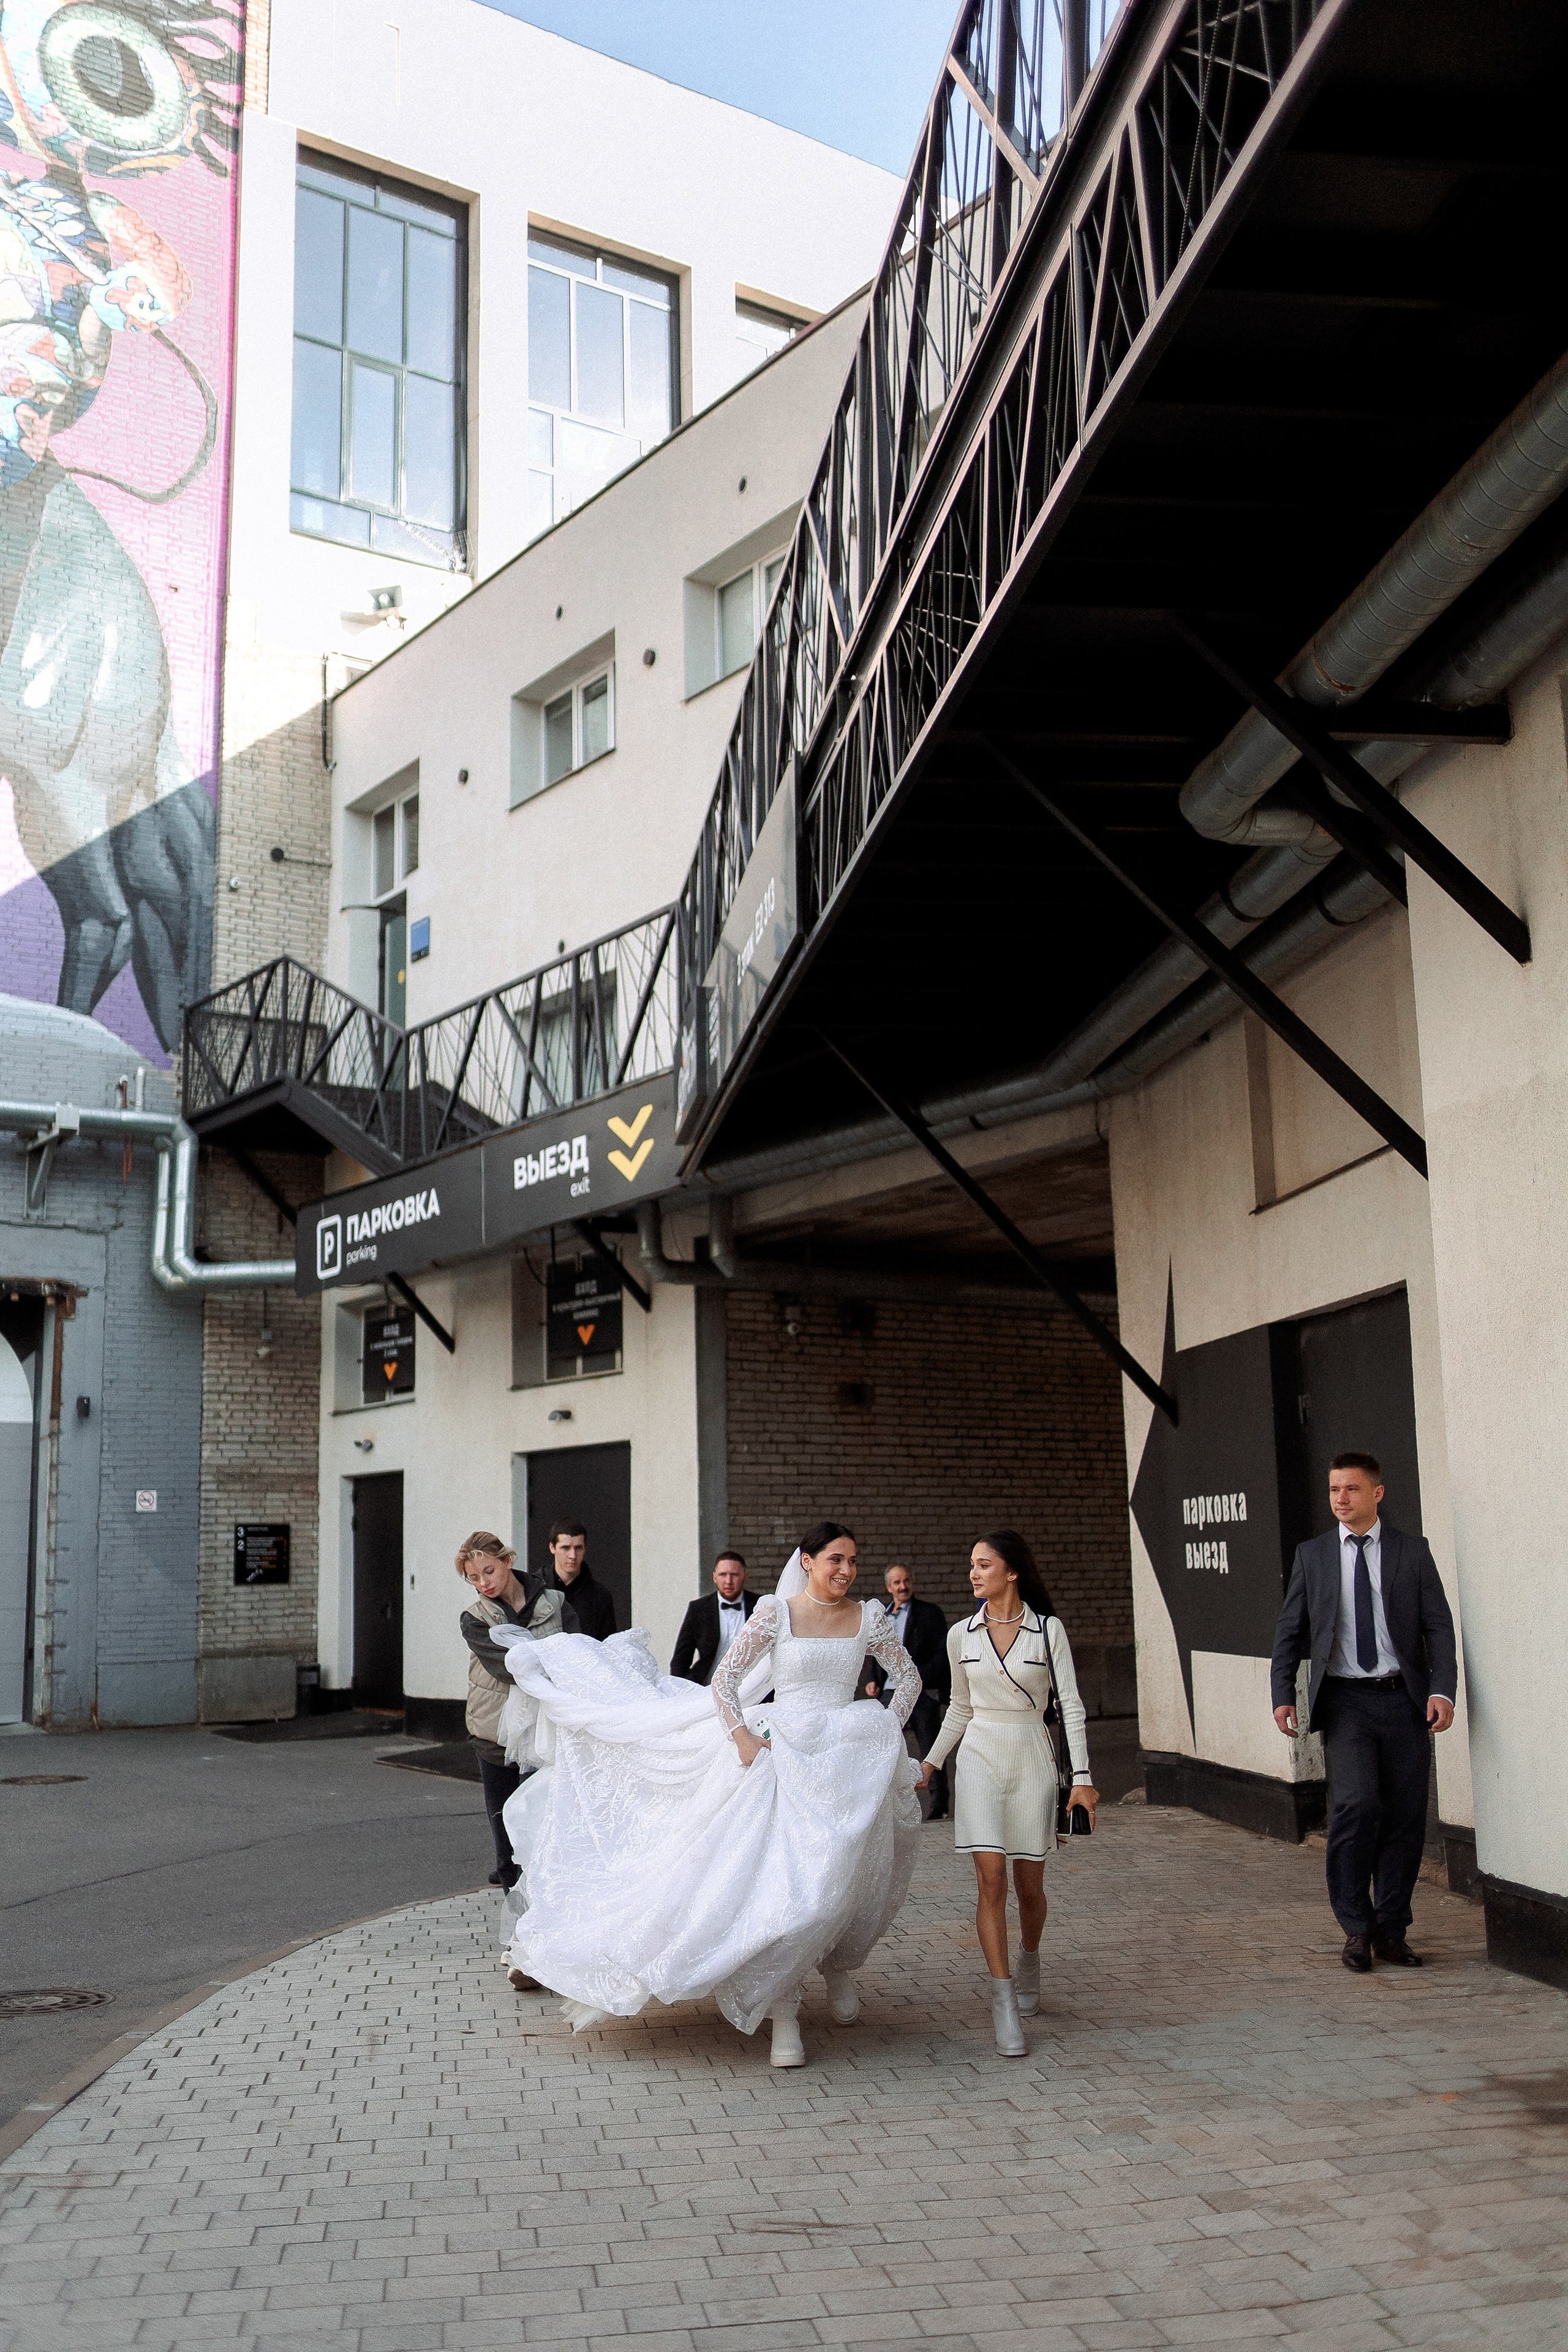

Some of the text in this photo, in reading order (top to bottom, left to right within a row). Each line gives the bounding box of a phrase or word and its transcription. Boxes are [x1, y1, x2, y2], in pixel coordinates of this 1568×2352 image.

[513, 1134, 589, 1190] ВЫЕЗД
[570, 1176, 590, 1197] exit
[346, 1188, 440, 1244] ПАРКОВКА
[346, 1245, 377, 1267] parking
[1183, 1492, 1247, 1531] парковка
[237, 1540, 244, 1551] 2
[1185, 1541, 1229, 1574] выезд
